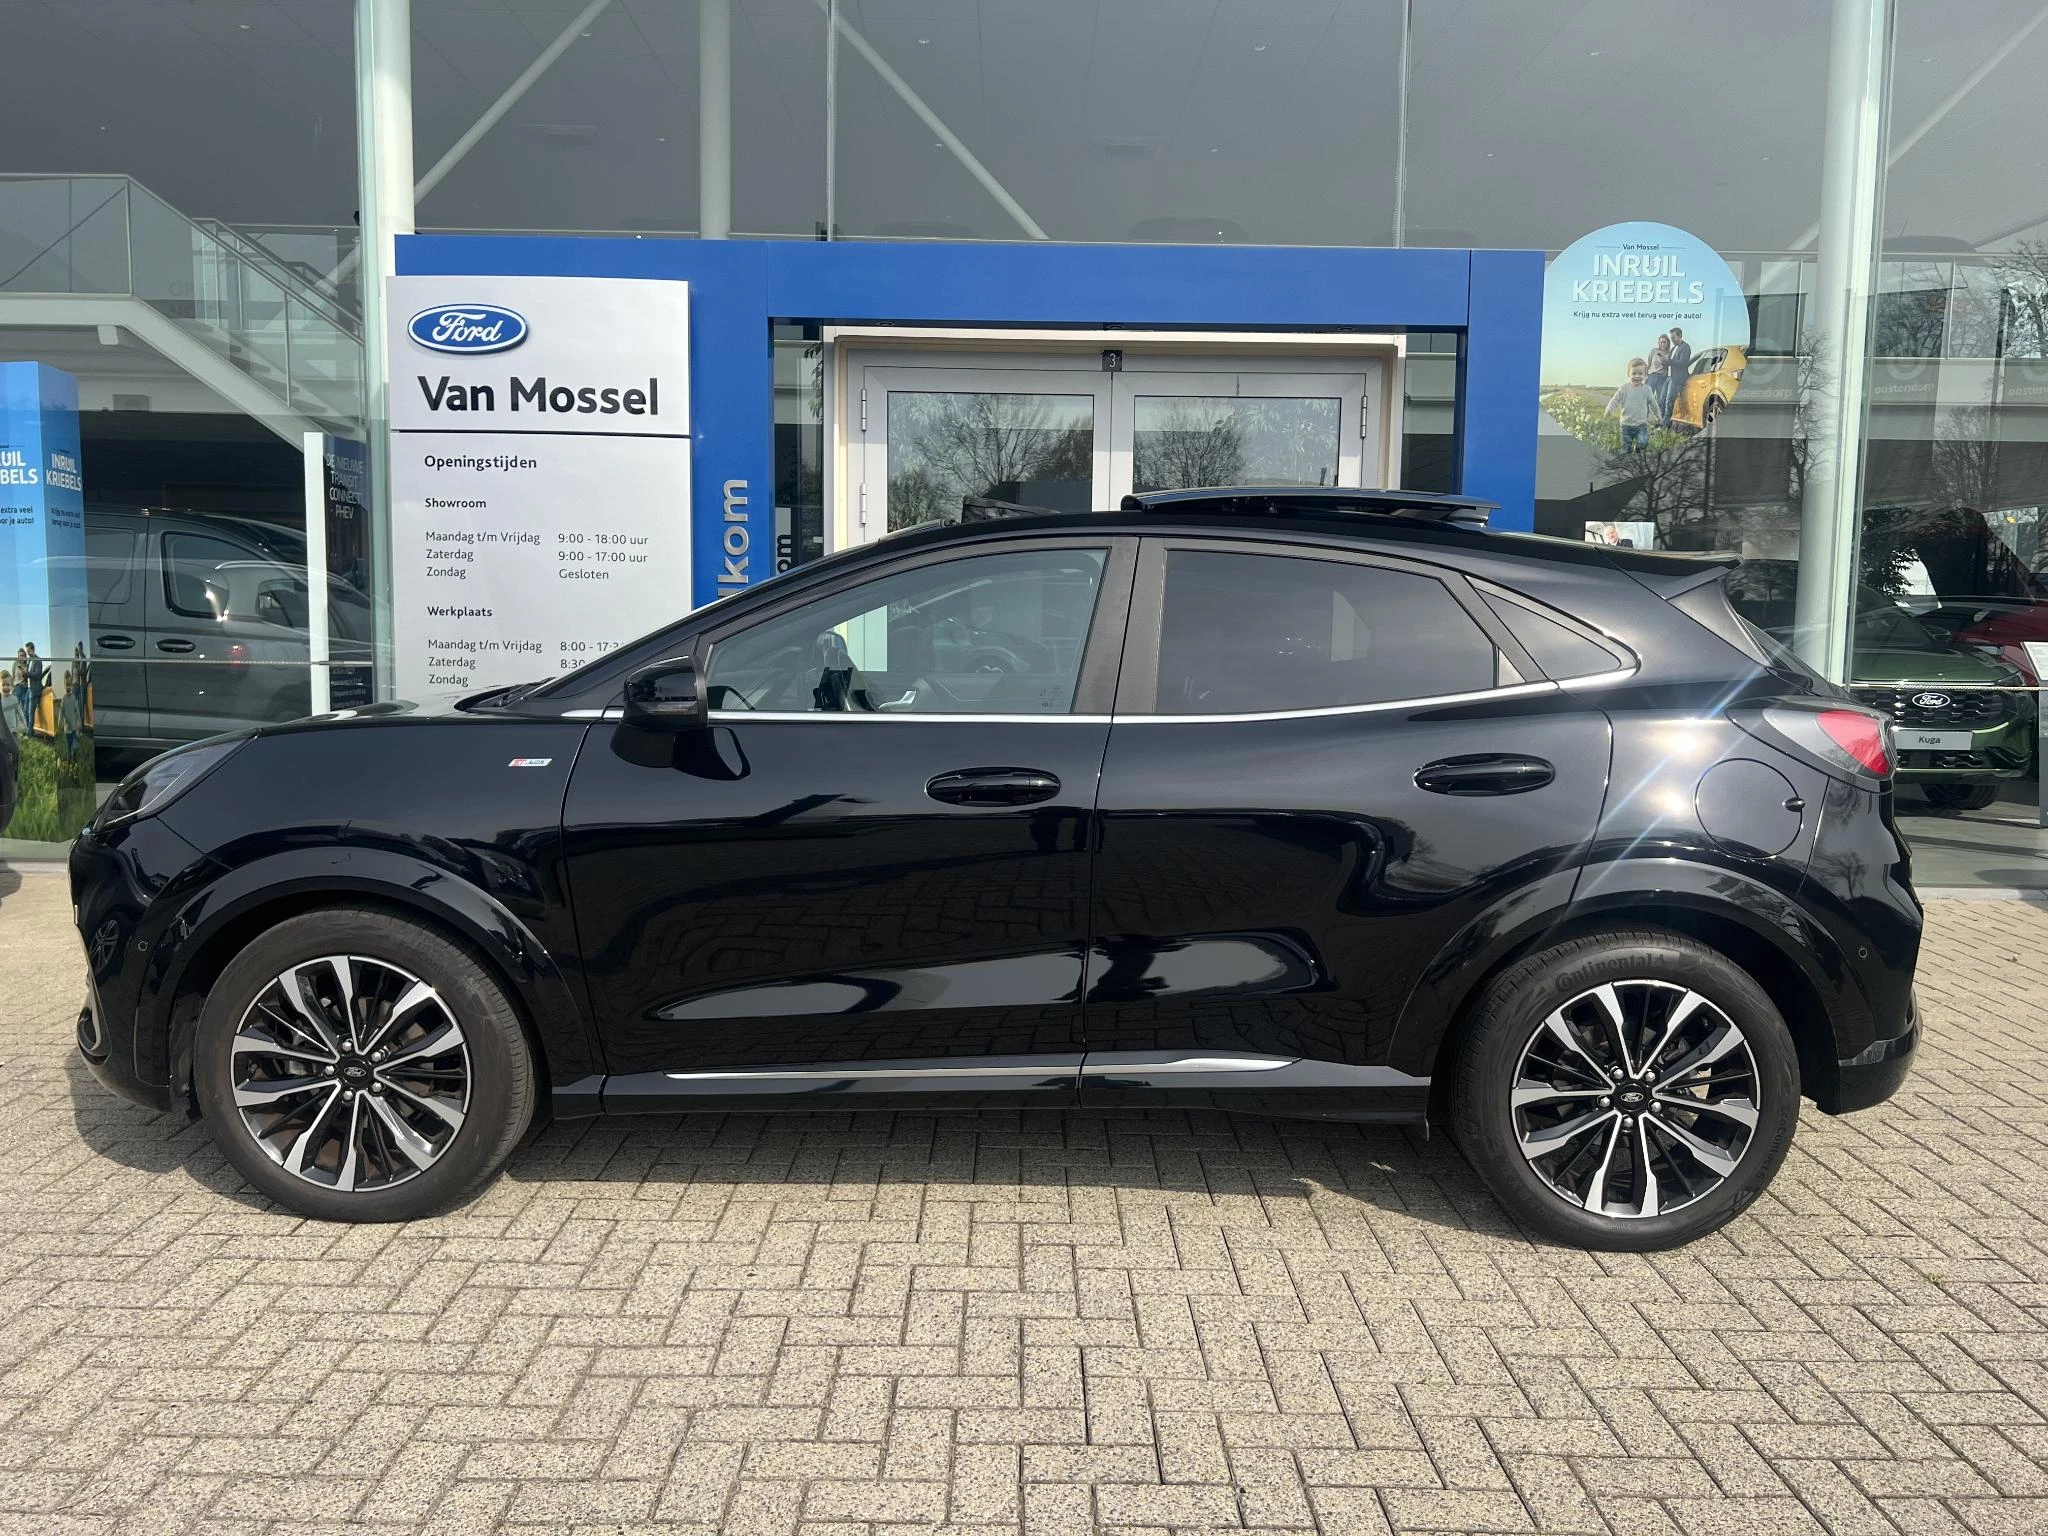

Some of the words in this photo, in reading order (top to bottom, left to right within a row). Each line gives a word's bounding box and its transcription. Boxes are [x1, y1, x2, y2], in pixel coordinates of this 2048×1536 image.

[1593, 254, 1686, 277] INRUIL
[1572, 280, 1705, 304] KRIEBELS
[1573, 310, 1591, 319] Krijg
[1638, 311, 1657, 319] terug
[1683, 311, 1702, 319] auto!
[432, 311, 504, 342] Ford
[1109, 353, 1116, 368] 3
[417, 375, 494, 411] Van
[510, 376, 658, 415] Mossel
[0, 451, 26, 467] UIL
[51, 453, 77, 473] INRUIL
[424, 455, 537, 471] Openingstijden
[46, 469, 81, 491] KRIEBELS
[19, 505, 33, 513] veel
[425, 498, 487, 509] Showroom
[335, 504, 354, 520] PHEV
[425, 531, 475, 545] Maandag
[476, 532, 497, 544] t/m
[500, 532, 541, 546] Vrijdag
[558, 533, 584, 544] 9:00
[595, 534, 627, 545] 18:00
[630, 536, 649, 545] uur
[426, 549, 474, 562] Zaterdag
[558, 551, 584, 561] 9:00
[595, 551, 626, 562] 17:00
[629, 553, 648, 563] uur
[426, 566, 467, 579] Zondag
[559, 569, 609, 580] Gesloten
[427, 606, 493, 618] Werkplaats
[428, 639, 476, 652] Maandag
[479, 640, 500, 651] t/m
[502, 640, 542, 653] Vrijdag
[560, 641, 586, 651] 8:00
[428, 656, 476, 669] Zaterdag
[429, 674, 469, 687] Zondag
[1919, 694, 1943, 705] Ford
[1919, 736, 1941, 744] Kuga
[1554, 953, 1651, 993] Continental
